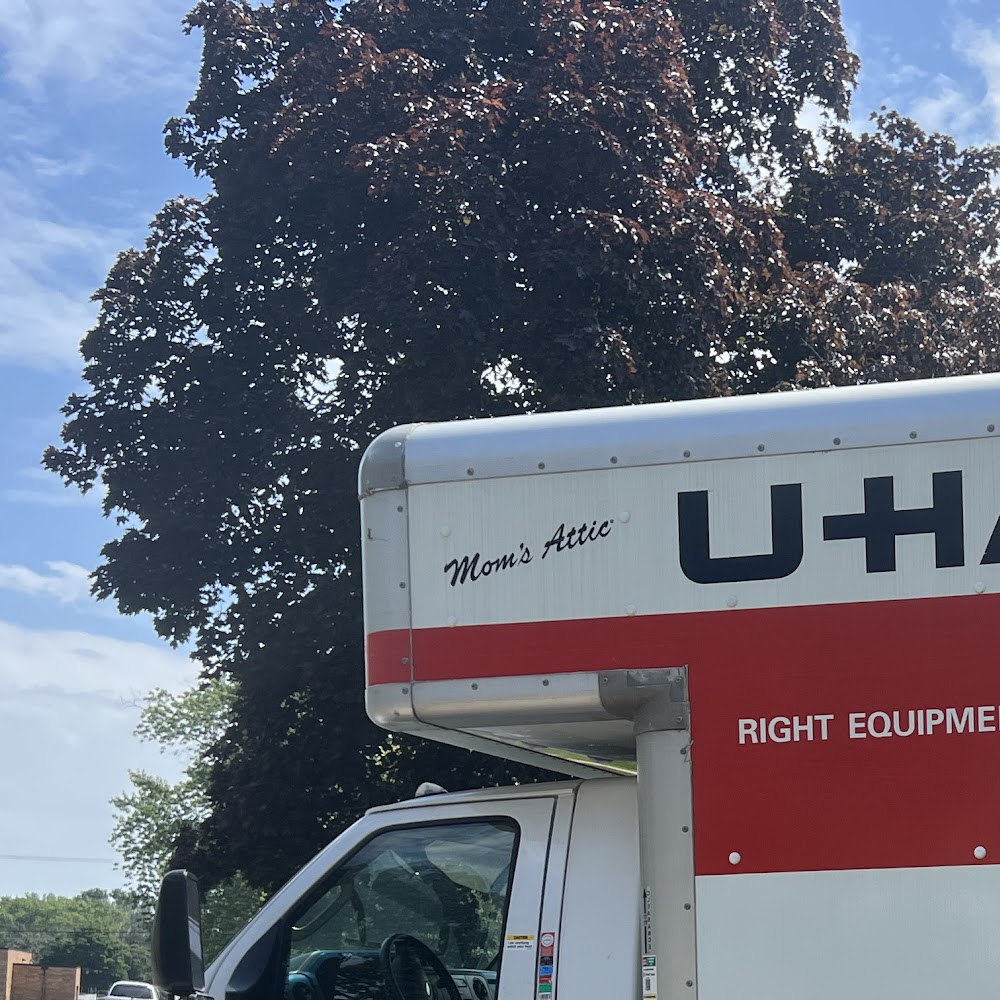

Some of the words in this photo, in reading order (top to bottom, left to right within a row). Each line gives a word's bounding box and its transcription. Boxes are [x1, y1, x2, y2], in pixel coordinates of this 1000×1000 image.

[443, 543, 533, 587] Mom's
[541, 520, 612, 559] Attic
[738, 714, 834, 745] RIGHT
